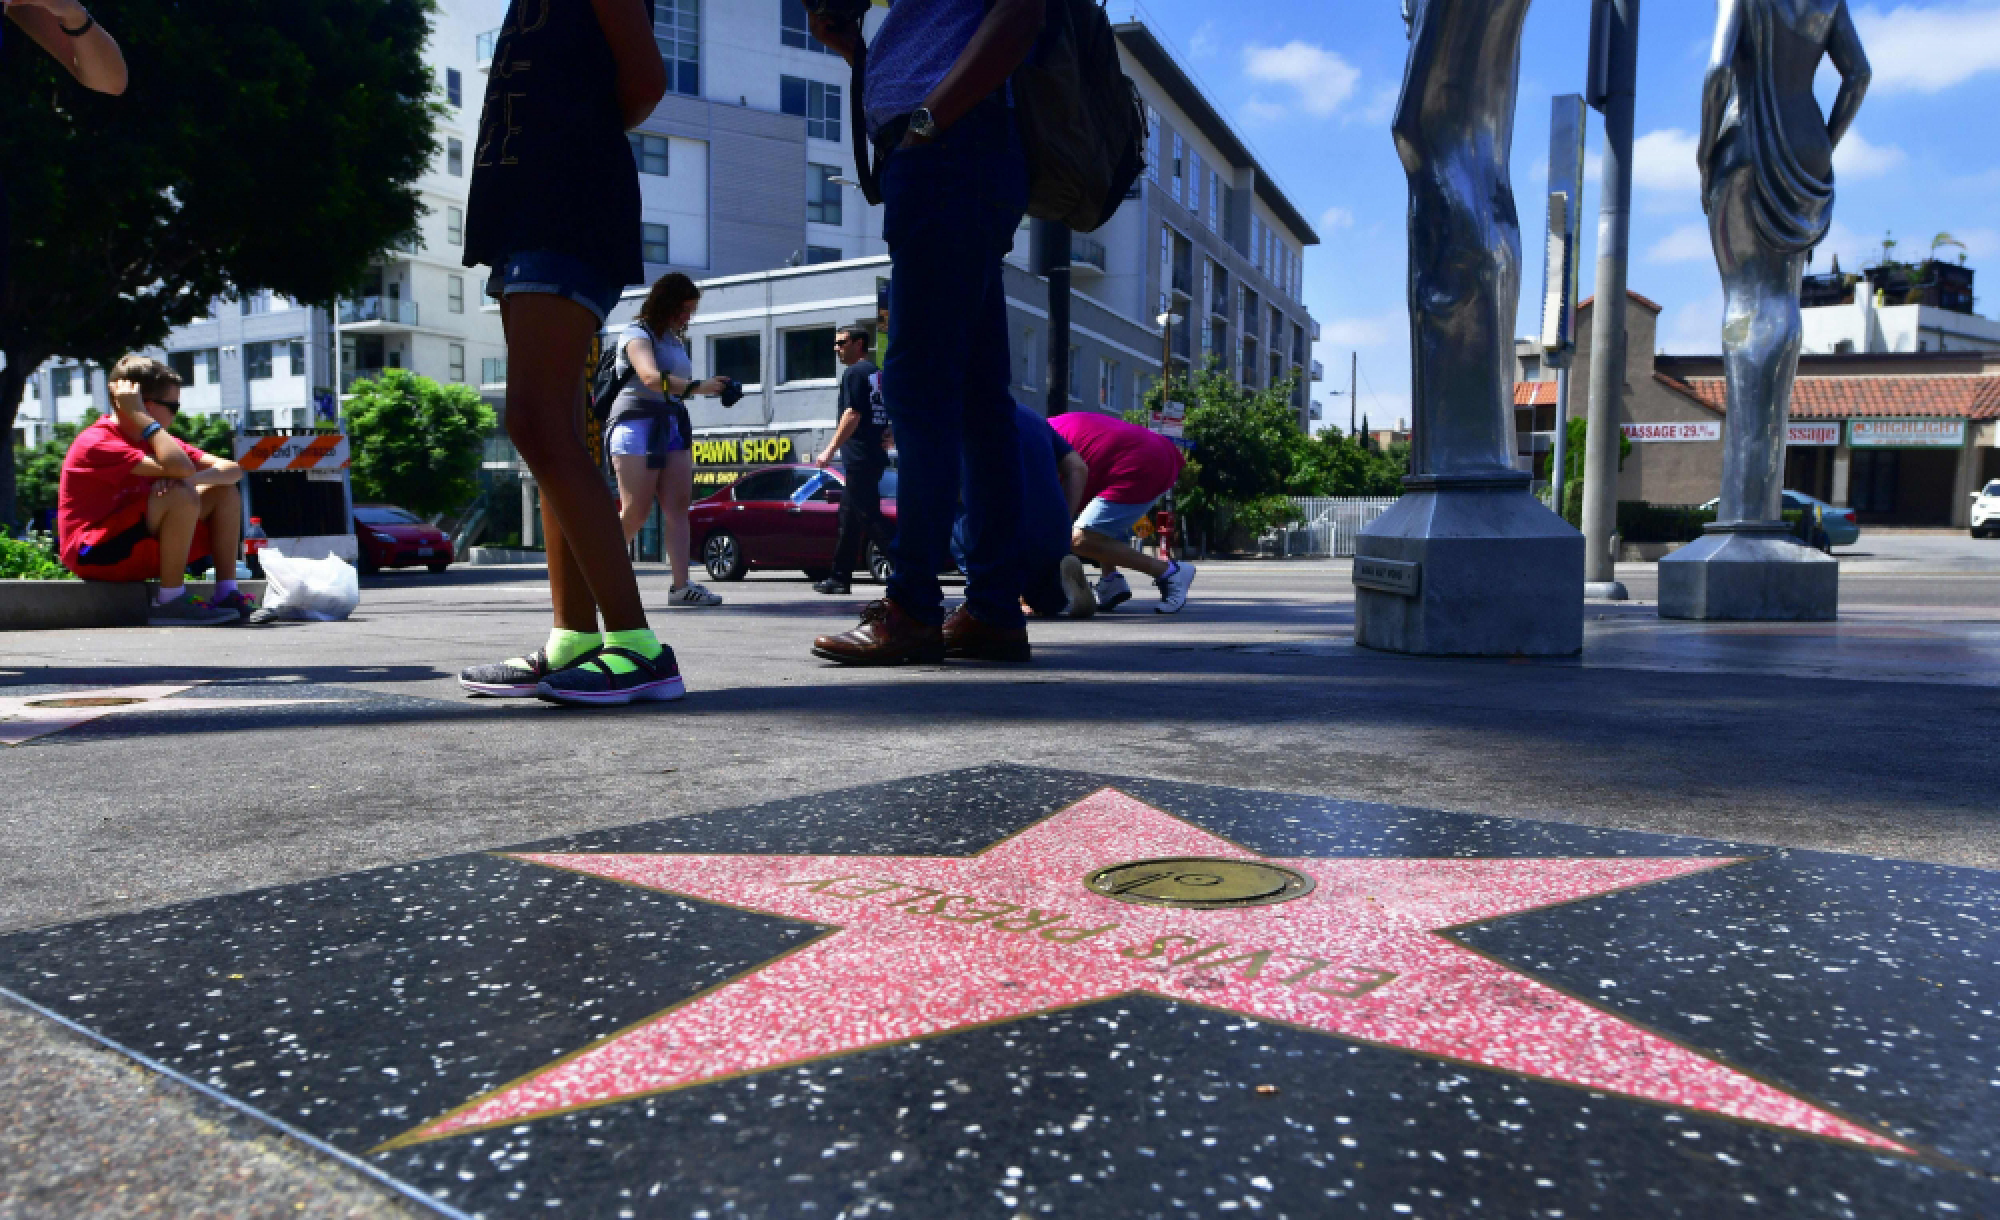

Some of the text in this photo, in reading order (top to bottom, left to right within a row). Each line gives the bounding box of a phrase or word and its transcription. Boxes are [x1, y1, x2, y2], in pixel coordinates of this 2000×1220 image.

[1623, 425, 1677, 438] MASSAGE
[1789, 427, 1835, 442] ssage
[1873, 421, 1961, 433] HIGHLIGHT
[693, 437, 791, 463] PAWN SHOP
[782, 875, 1400, 999] ELVIS PRESLEY
